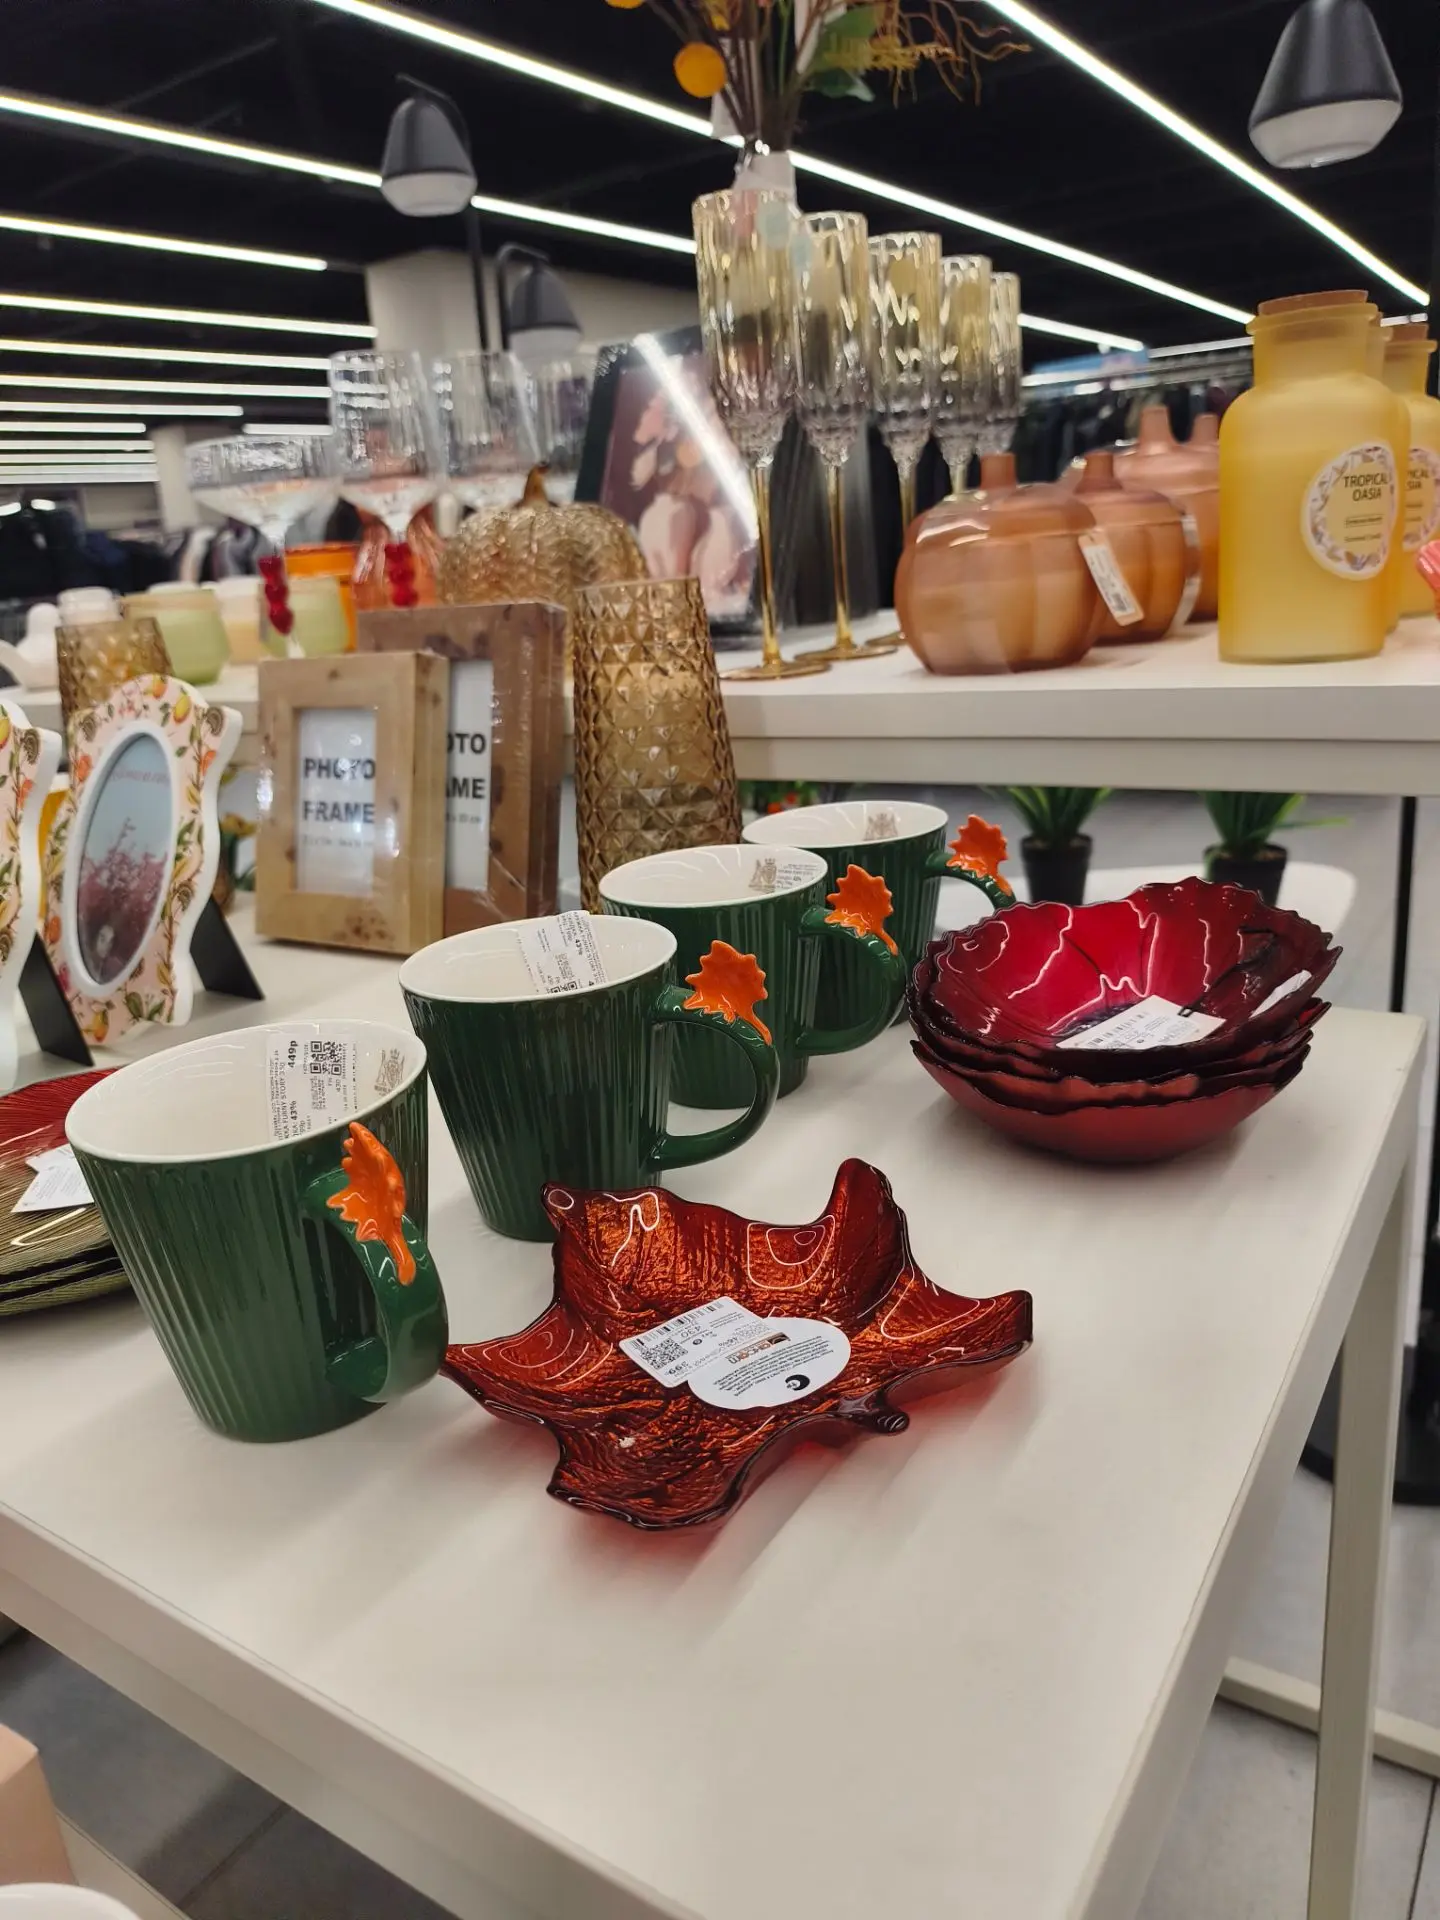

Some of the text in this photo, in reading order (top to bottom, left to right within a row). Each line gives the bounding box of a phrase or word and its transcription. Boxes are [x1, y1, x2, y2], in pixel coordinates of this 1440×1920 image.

[1343, 473, 1388, 488] TROPICAL
[1352, 488, 1382, 502] OASIA
[303, 800, 375, 824] FRAME
[290, 1100, 298, 1121] 43%
